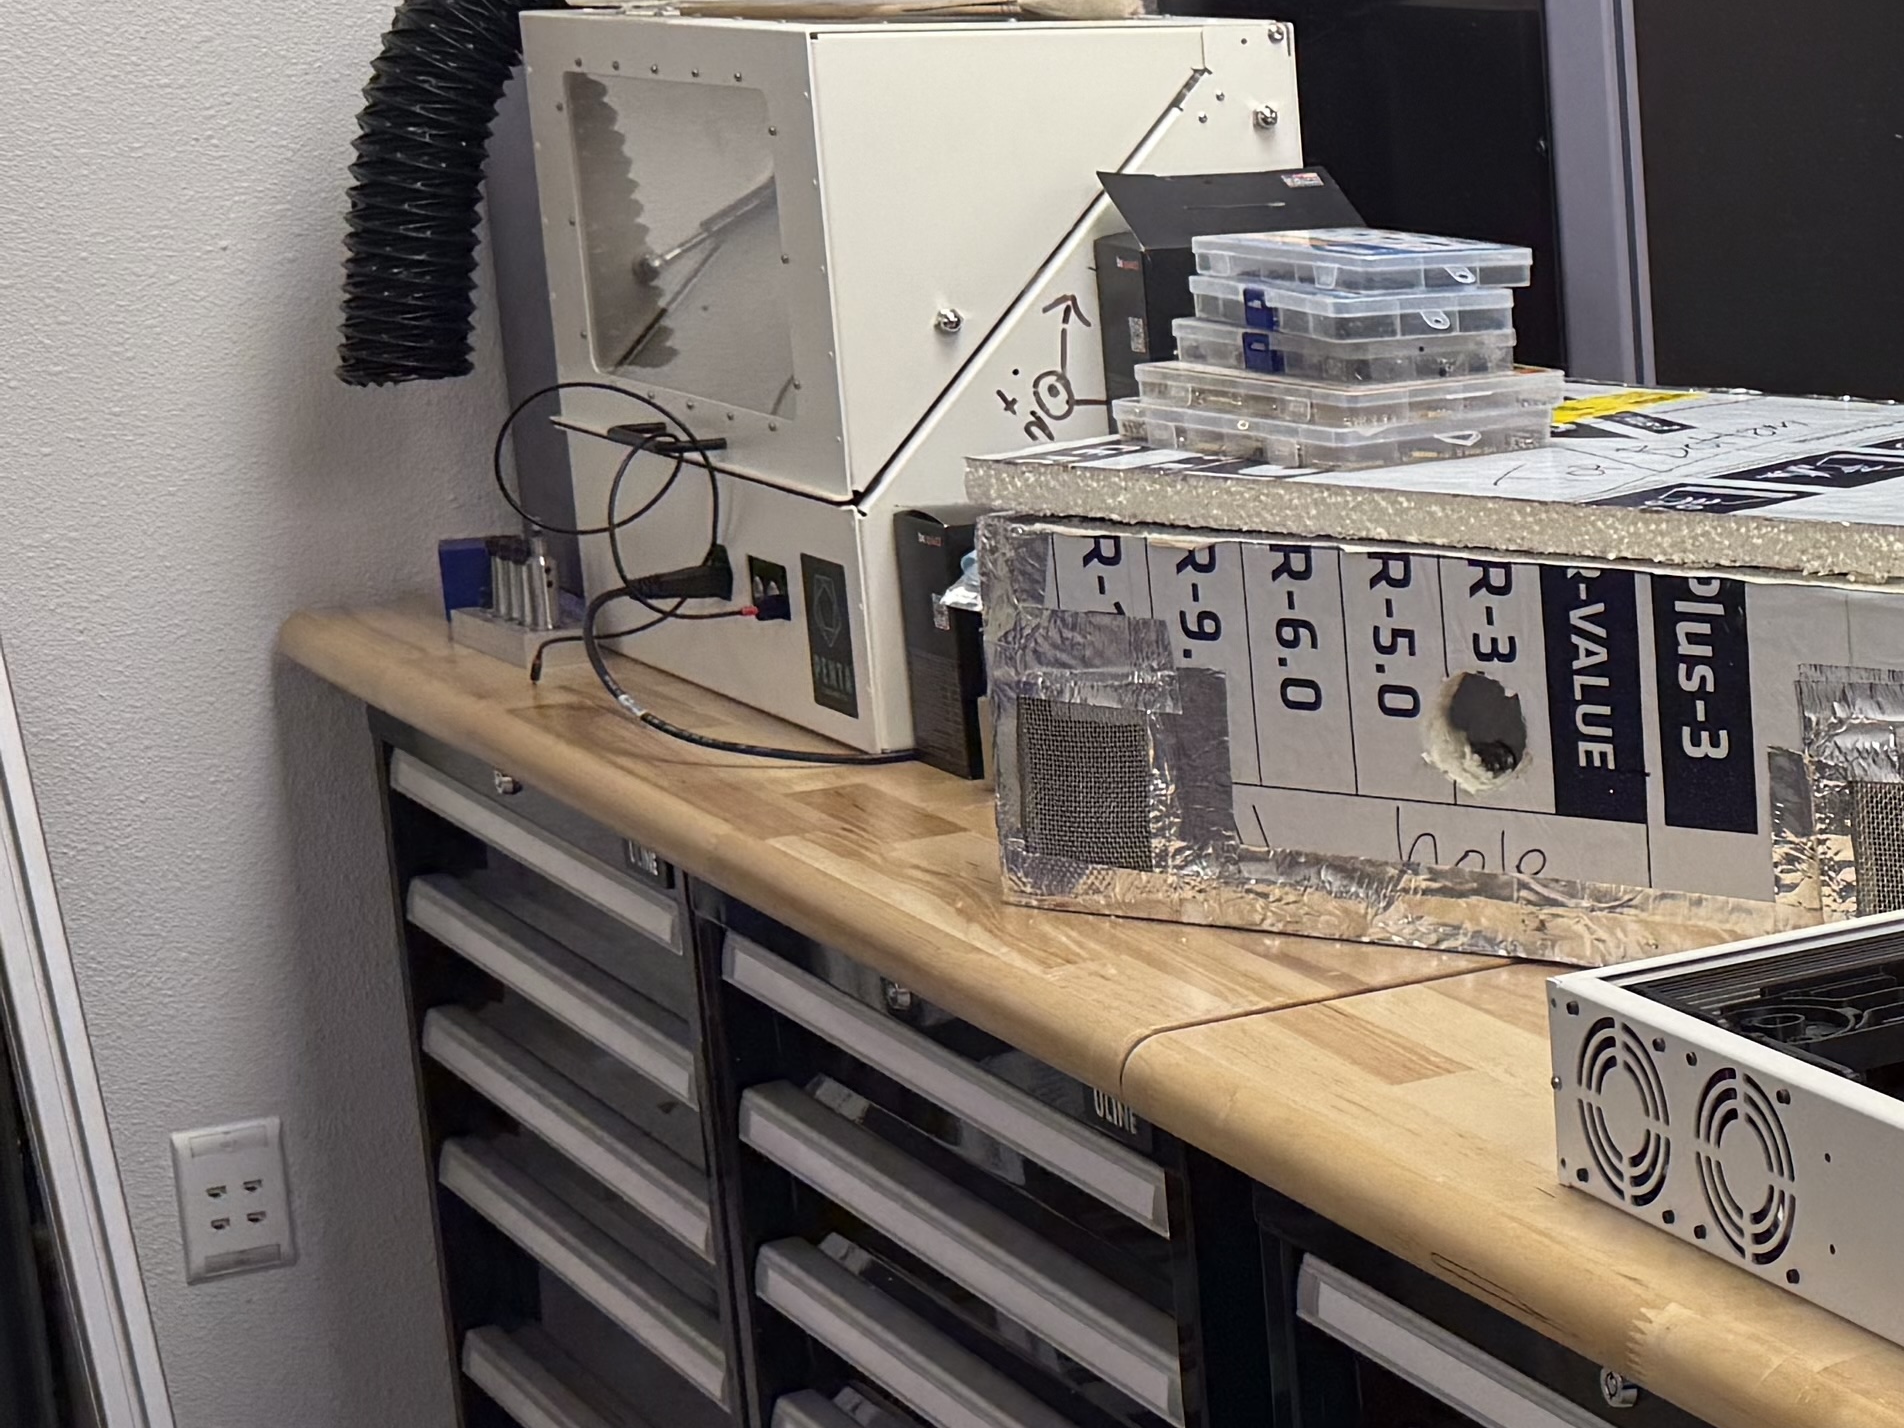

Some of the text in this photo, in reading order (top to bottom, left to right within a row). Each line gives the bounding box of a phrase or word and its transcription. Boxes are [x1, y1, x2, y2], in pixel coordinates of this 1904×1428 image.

[1270, 544, 1322, 712] R-6.0
[1367, 552, 1421, 719] R-5.0
[1093, 1088, 1137, 1135] ULINE
